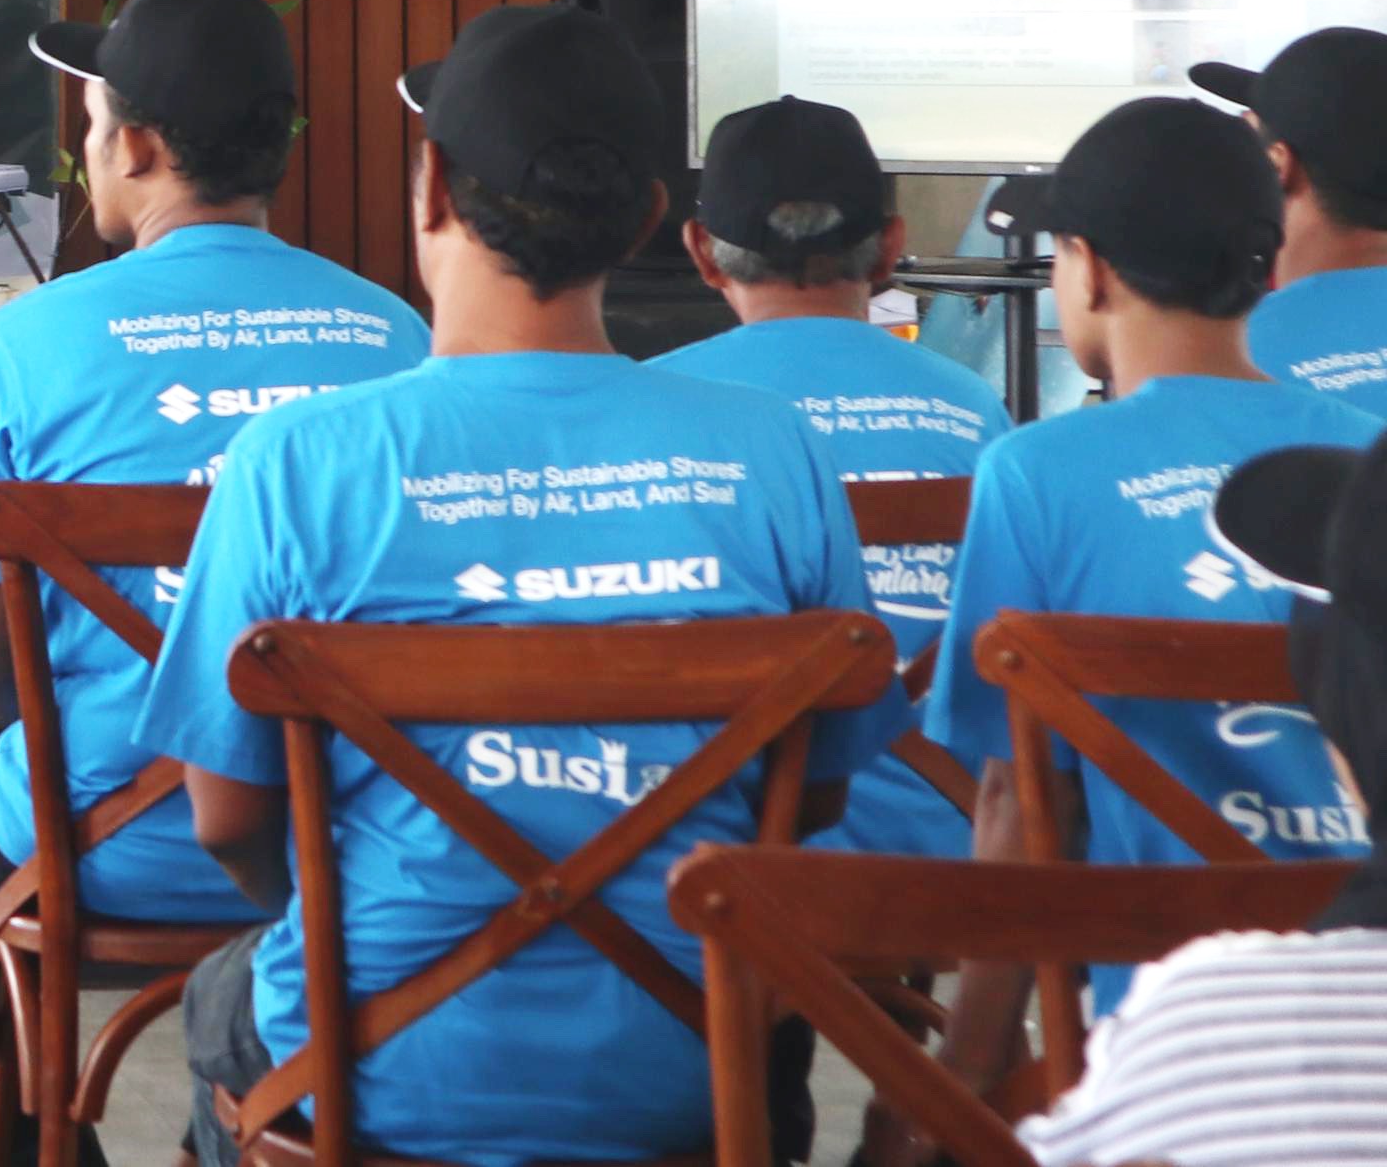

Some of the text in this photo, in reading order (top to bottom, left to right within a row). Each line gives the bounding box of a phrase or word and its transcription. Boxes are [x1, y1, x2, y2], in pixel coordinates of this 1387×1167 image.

[109, 312, 201, 335] Mobilizing
[202, 309, 232, 328] For
[235, 307, 333, 327] Sustainable
[122, 331, 204, 355] Together
[207, 331, 231, 350] By
[234, 328, 263, 347] Air,
[265, 327, 314, 345] Land,
[316, 326, 351, 343] And
[208, 385, 342, 417] SUZ
[802, 395, 832, 414] For
[833, 394, 931, 413] Sustainable
[810, 414, 834, 435] By
[914, 413, 949, 434] And
[402, 471, 505, 498] Mobilizing
[506, 467, 540, 490] For
[542, 459, 669, 489] Sustainable
[416, 497, 509, 526] Together
[511, 493, 540, 521] By
[543, 491, 578, 516] Air,
[580, 486, 643, 512] Land,
[646, 483, 691, 505] And
[514, 555, 720, 603] SUZUKI
[466, 730, 629, 801] Susi
[1221, 788, 1374, 846] Susi
